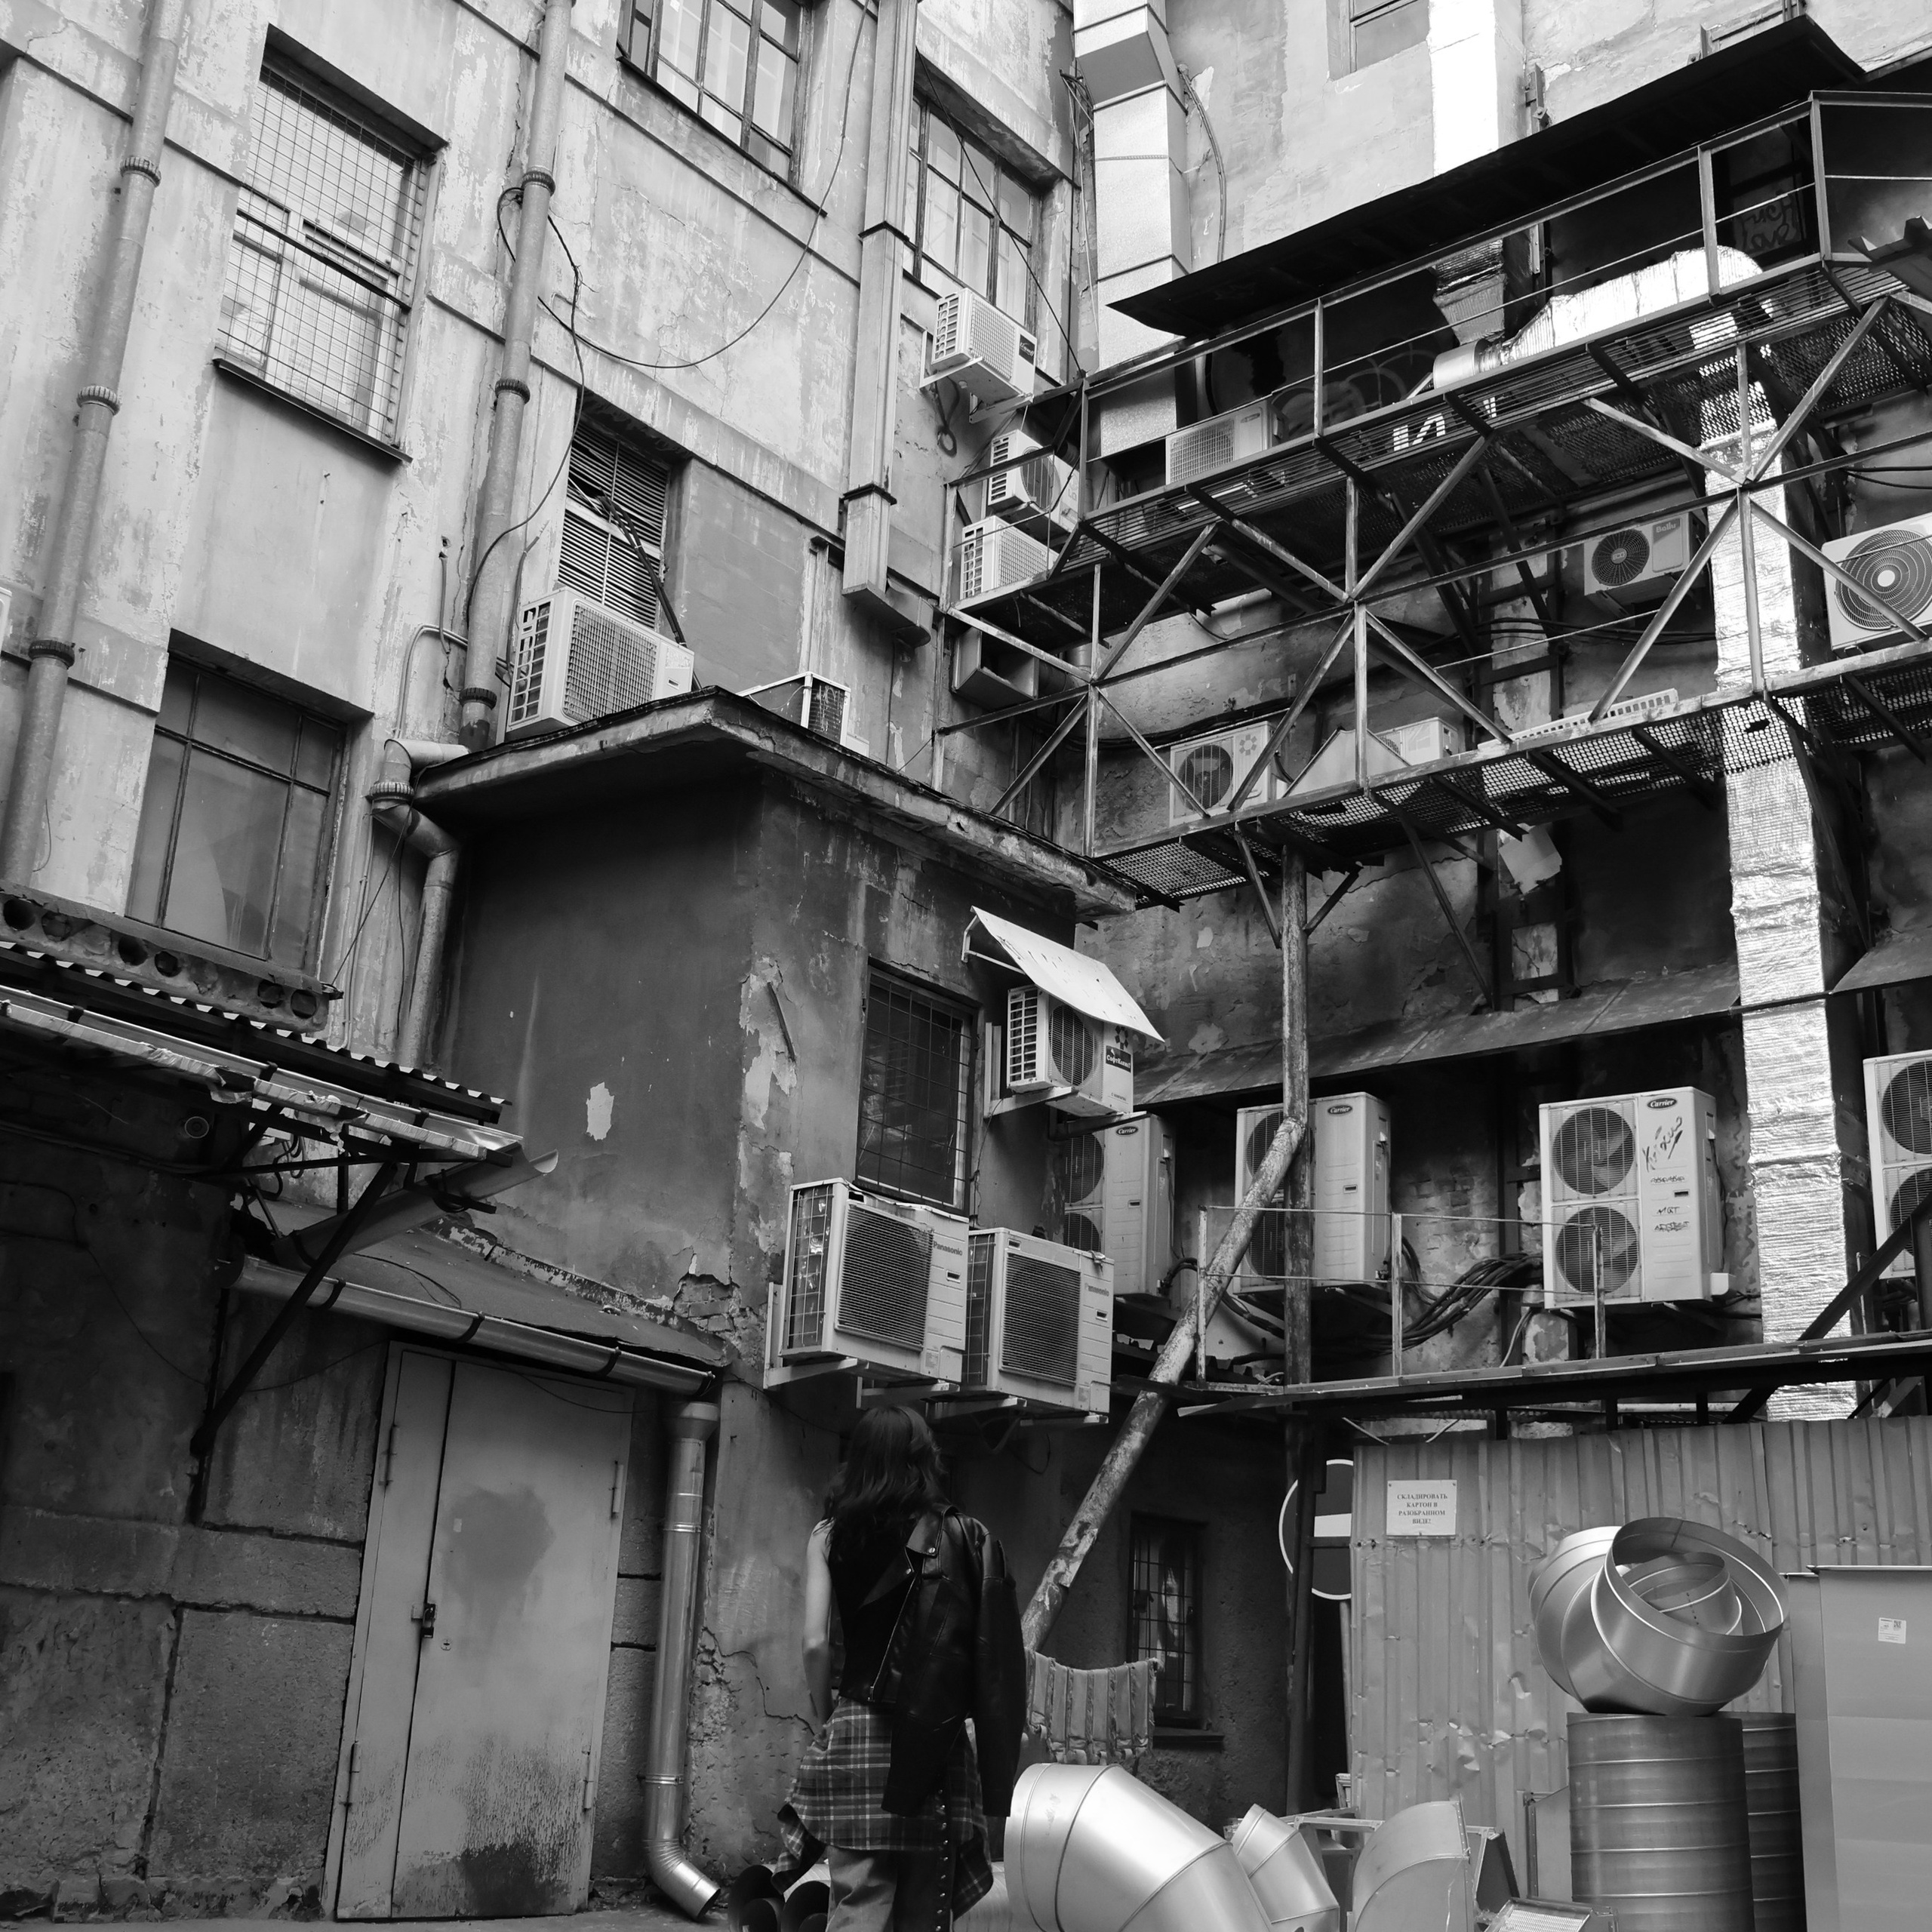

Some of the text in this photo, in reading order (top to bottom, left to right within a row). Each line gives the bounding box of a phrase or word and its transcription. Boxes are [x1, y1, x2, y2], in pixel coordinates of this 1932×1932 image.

[1656, 521, 1676, 533] Ballu
[1650, 1099, 1675, 1108] Carrier
[1118, 1127, 1137, 1135] Carrier
[933, 1240, 963, 1256] Panasonic
[1084, 1282, 1110, 1297] Panasonic
